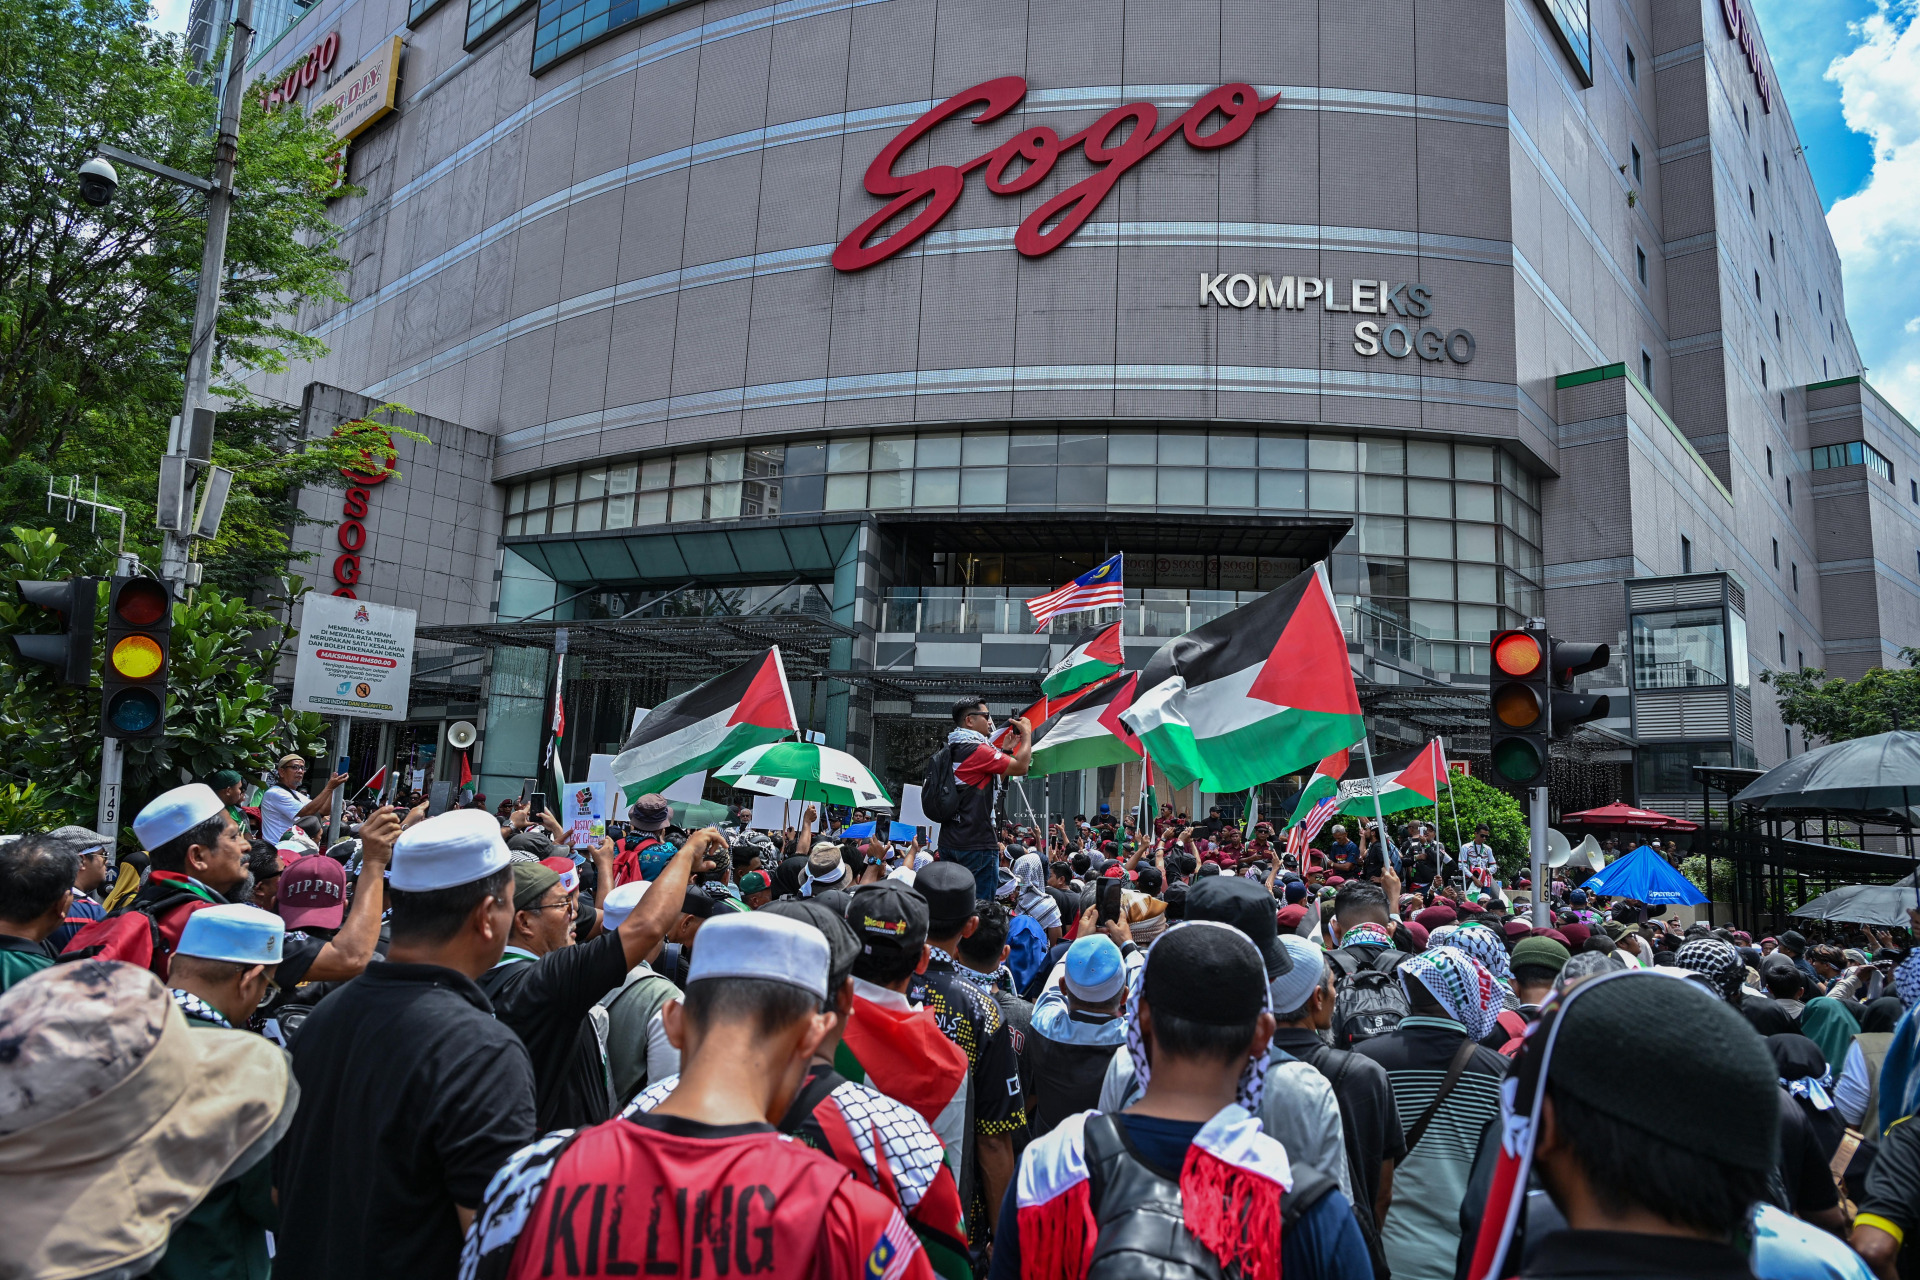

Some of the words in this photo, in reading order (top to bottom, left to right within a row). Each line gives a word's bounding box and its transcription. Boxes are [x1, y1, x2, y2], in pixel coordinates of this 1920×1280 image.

[355, 91, 379, 115] Prices
[831, 76, 1282, 272] Sogo
[1200, 272, 1433, 318] KOMPLEKS
[1354, 320, 1477, 363] SOGO
[1172, 559, 1203, 570] SOGO
[1223, 560, 1255, 571] SOGO
[328, 624, 366, 635] MEMBUANG
[366, 630, 392, 639] SAMPAH
[329, 631, 373, 642] MERATA-RATA
[374, 637, 397, 646] TEMPAT
[310, 634, 351, 645] MERUPAKAN
[369, 643, 405, 653] KESALAHAN
[324, 643, 346, 651] BOLEH
[347, 646, 384, 656] DIKENAKAN
[384, 651, 405, 659] DENDA
[320, 651, 360, 662] MAKSIMUM
[360, 657, 392, 666] RM500.00
[106, 785, 116, 821] 149
[287, 879, 340, 899] FIPPER
[541, 1182, 778, 1279] KILLING
